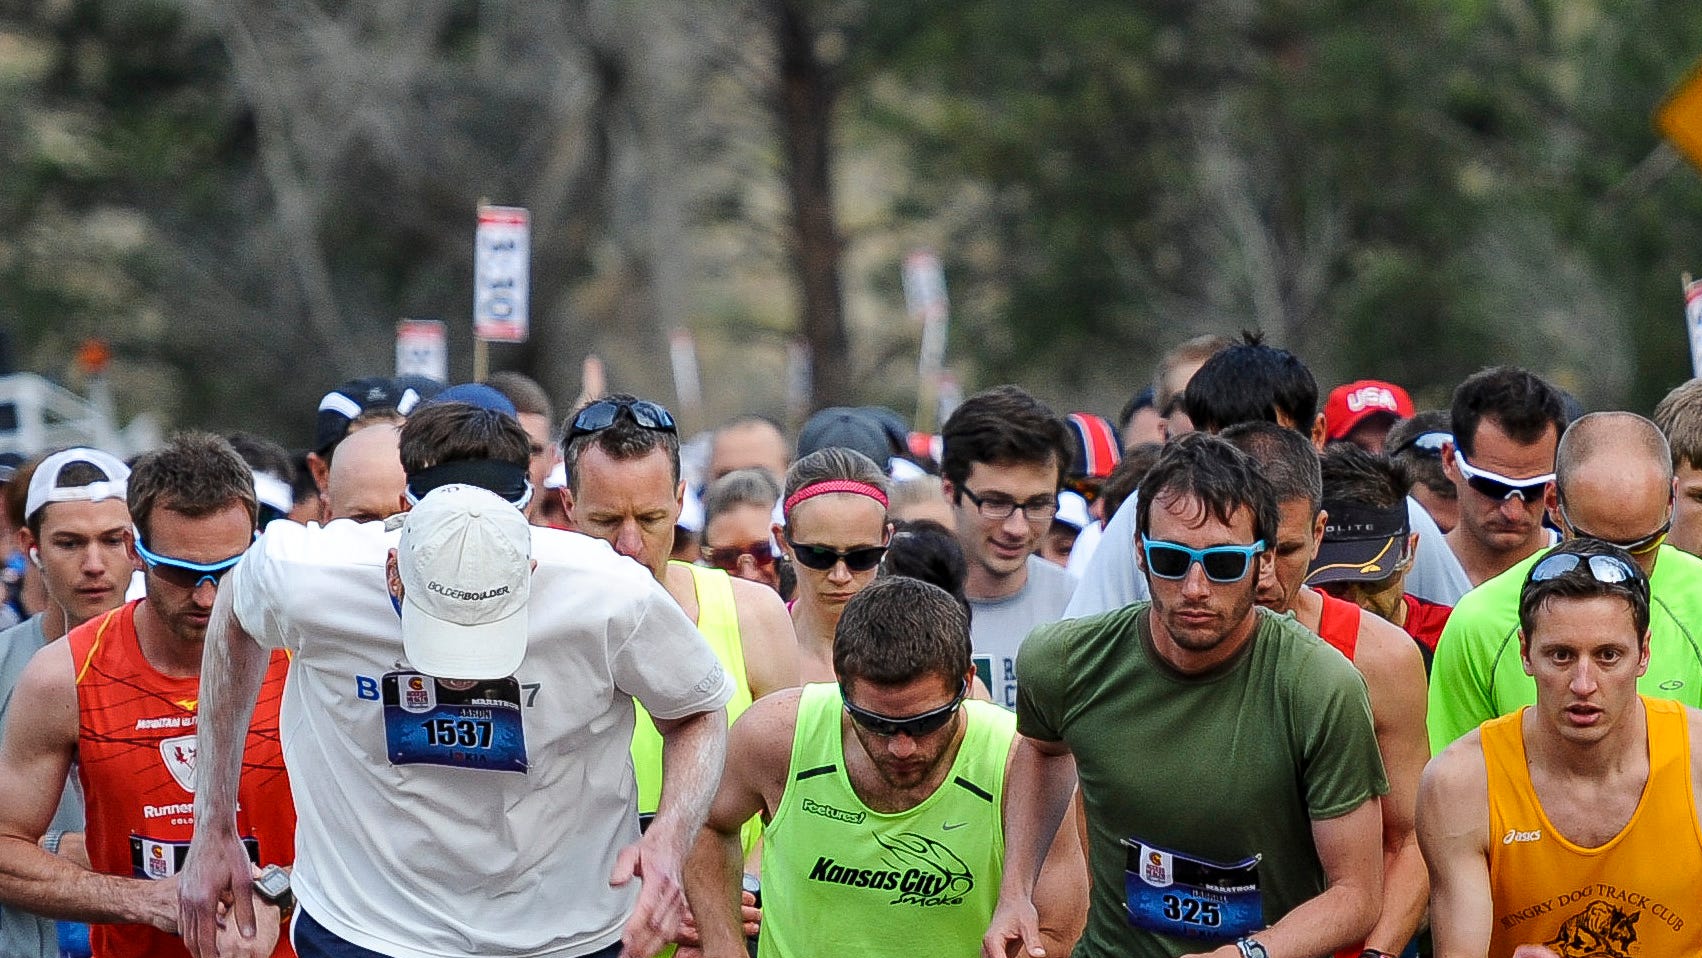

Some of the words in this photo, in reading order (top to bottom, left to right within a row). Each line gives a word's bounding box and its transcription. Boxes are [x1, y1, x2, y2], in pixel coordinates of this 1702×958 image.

[1347, 387, 1398, 412] USA
[1326, 523, 1375, 532] OLITE
[427, 581, 510, 601] BOLDERBOULDER
[421, 719, 495, 750] 1537
[144, 803, 193, 818] Runner
[803, 799, 866, 824] Feetures!
[809, 857, 901, 890] Kansas
[900, 866, 951, 897] City
[1205, 884, 1256, 893] MARATHON
[1163, 895, 1221, 928] 325
[1501, 899, 1554, 930] HUNGRY
[1557, 886, 1593, 908] DOG
[1597, 884, 1650, 910] TRACK
[1651, 903, 1685, 932] CLUB
